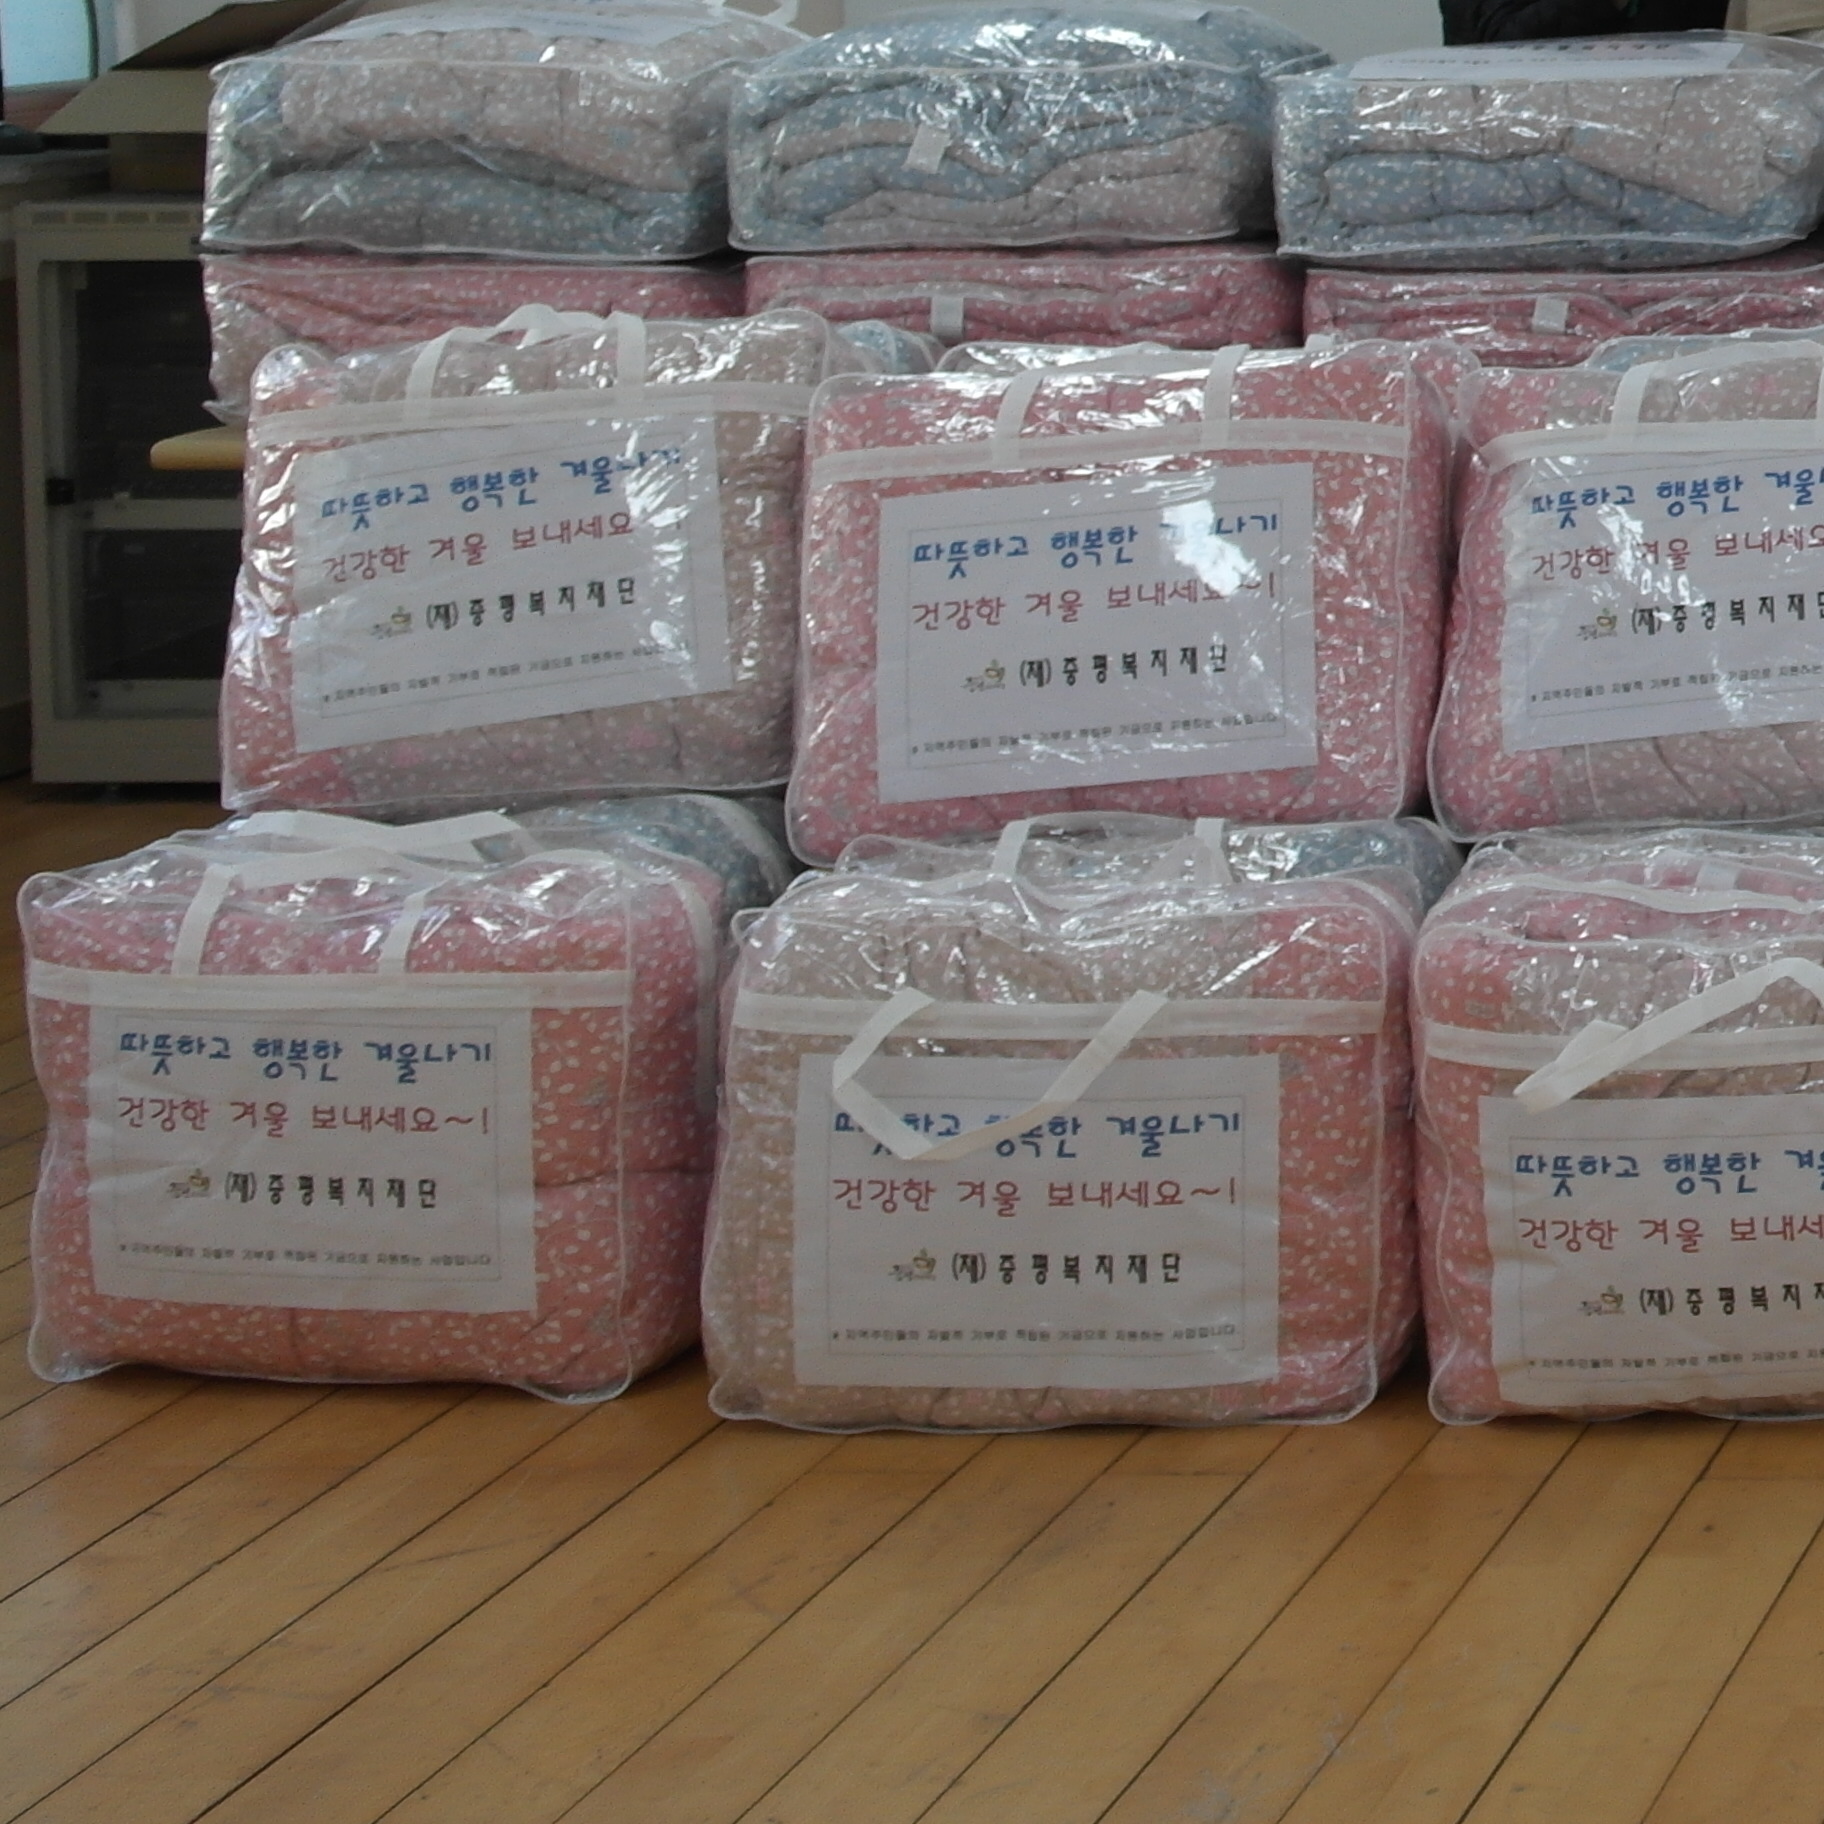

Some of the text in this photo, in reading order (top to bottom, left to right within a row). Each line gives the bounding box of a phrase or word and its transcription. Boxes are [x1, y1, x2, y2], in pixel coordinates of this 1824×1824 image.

[321, 484, 429, 531] 따뜻하고
[450, 467, 538, 512] 행복한
[1531, 485, 1635, 529] 따뜻하고
[1656, 476, 1744, 517] 행복한
[321, 511, 682, 583] 건강한 겨울 보내세요
[913, 514, 1278, 579] 따뜻하고 행복한 나기
[1531, 545, 1614, 581] 건강한
[1638, 538, 1691, 570] 겨울
[911, 595, 1006, 631] 건강한
[1025, 590, 1083, 623] 겨울
[120, 1033, 491, 1084] 따뜻하고 행복한 겨울나기
[118, 1096, 489, 1138] 건강한 겨울 보내세요~!
[833, 1112, 961, 1156] 따하고
[1106, 1112, 1240, 1158] 겨울나기
[832, 1177, 1236, 1218] 건강한 겨울 보내세요~!
[1515, 1154, 1639, 1197] 따뜻하고
[1663, 1153, 1760, 1195] 행복한
[1518, 1218, 1619, 1253] 건강한
[1639, 1219, 1704, 1254] 겨울
